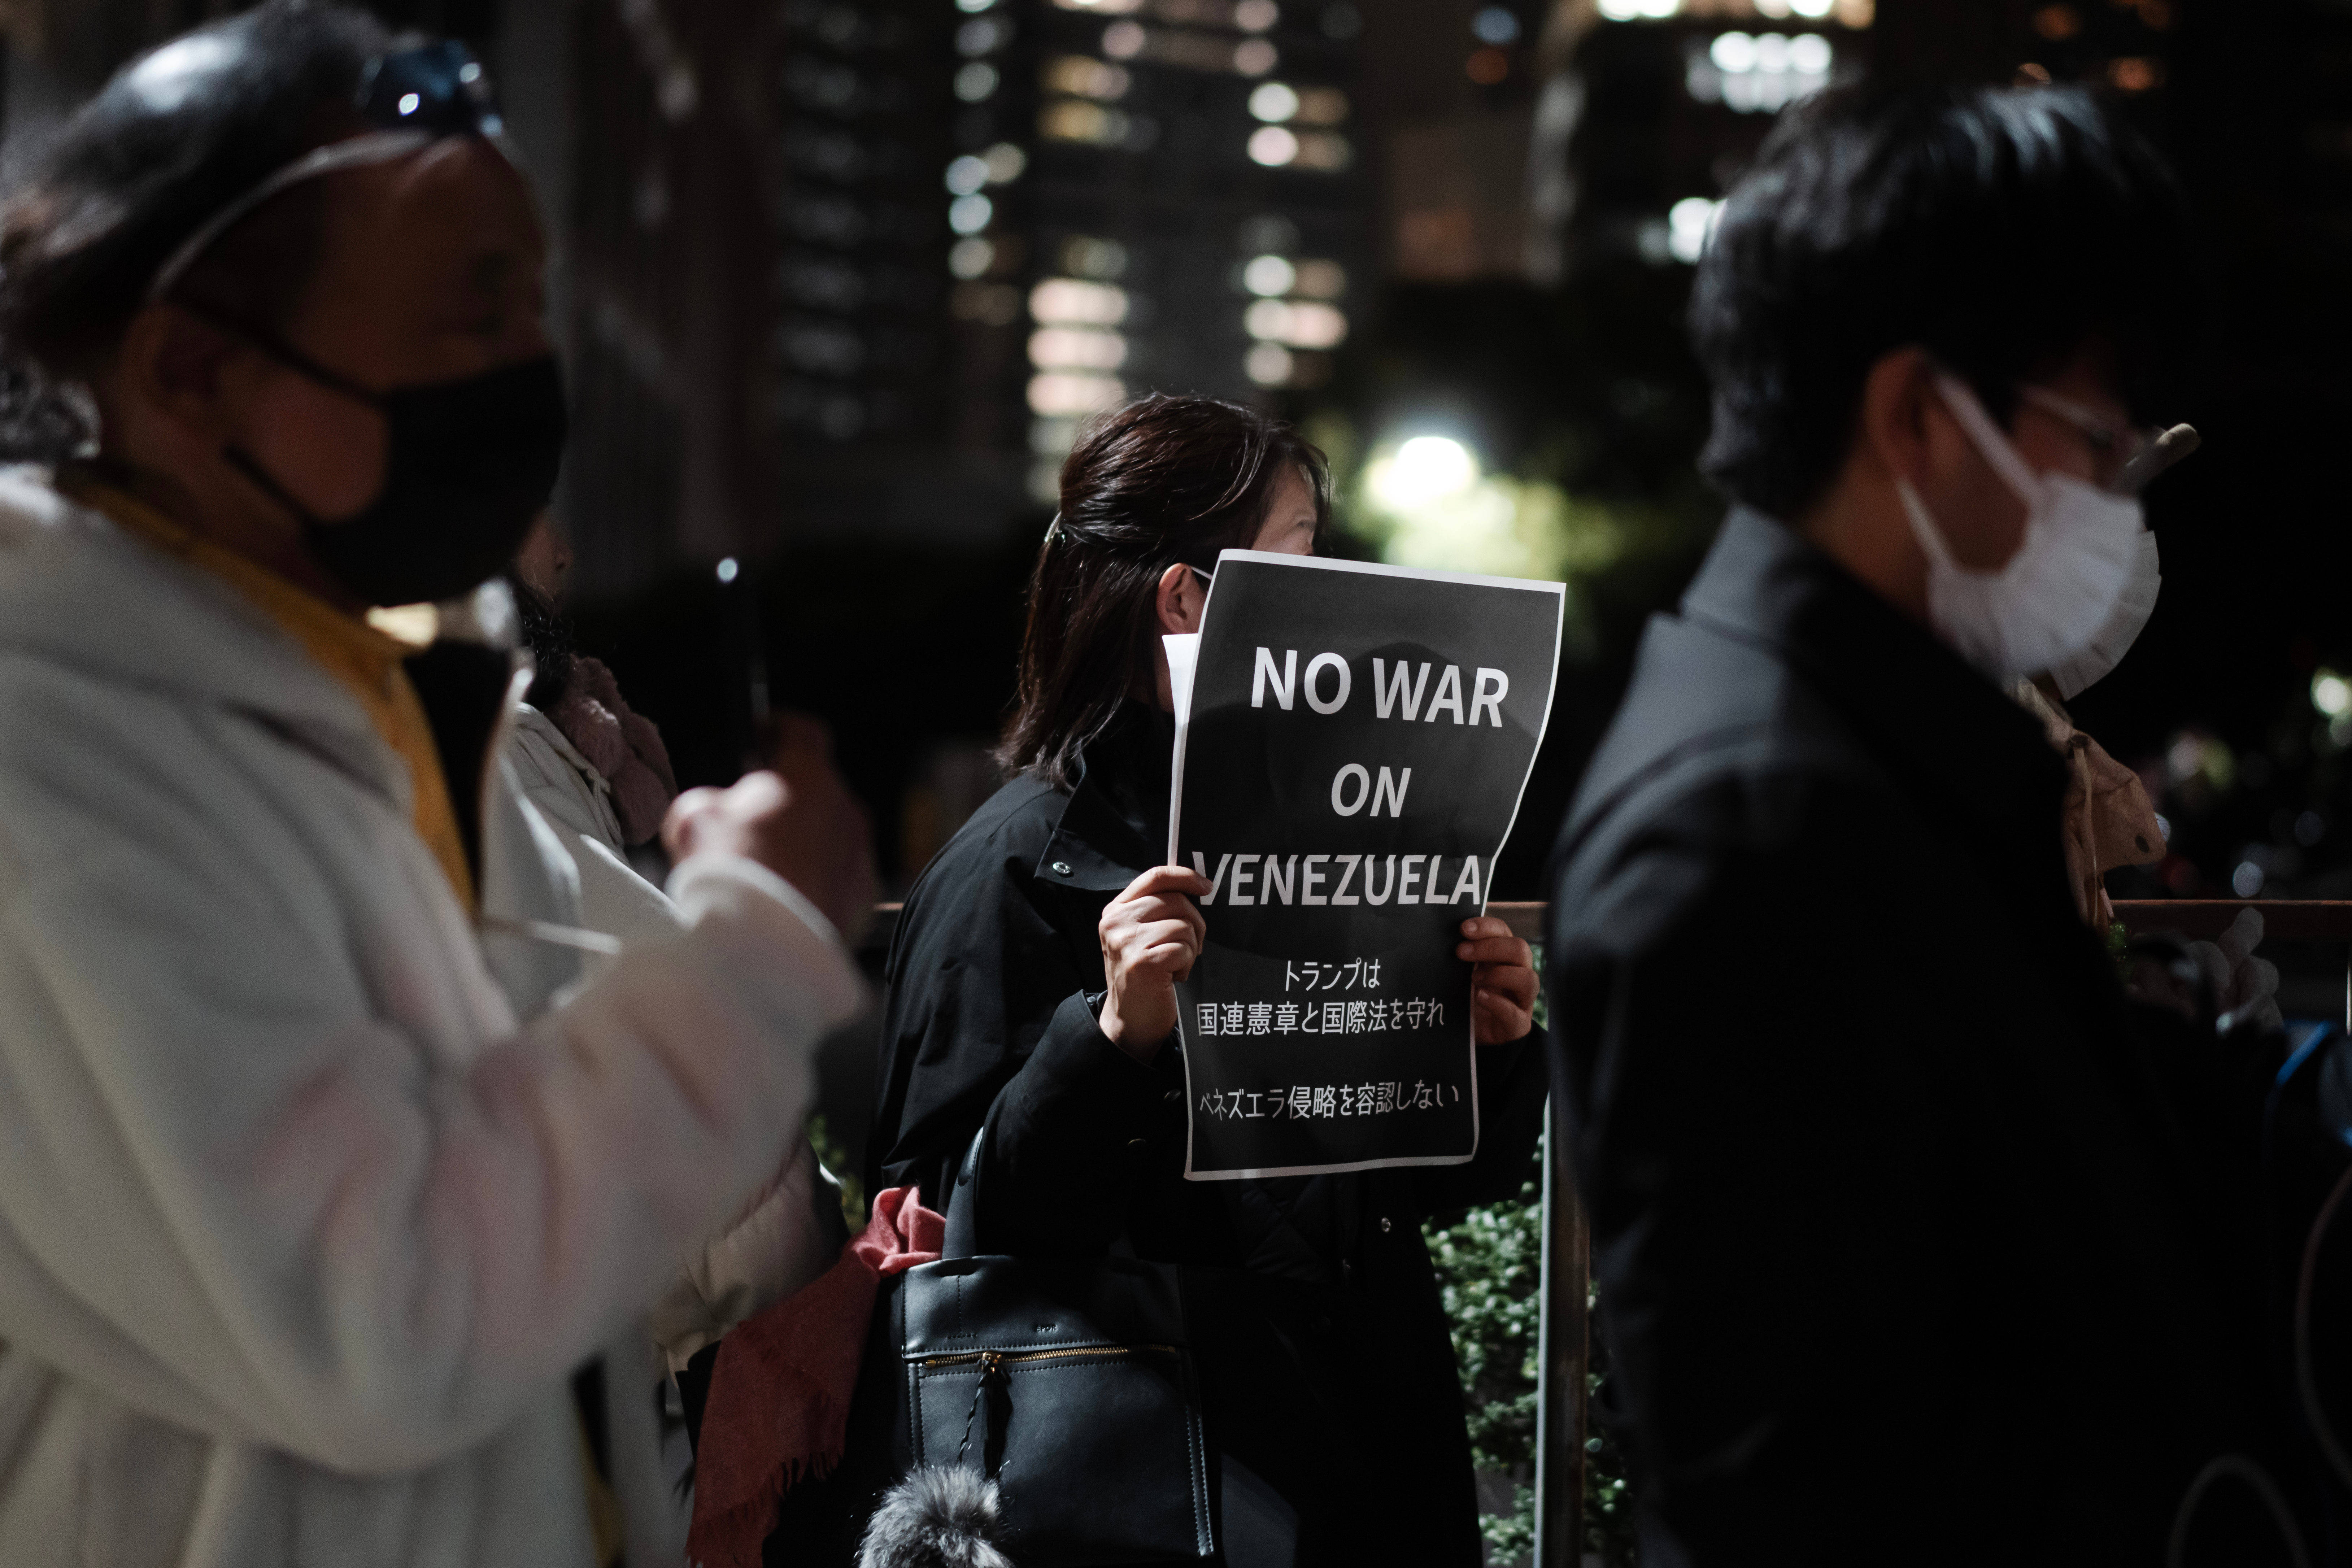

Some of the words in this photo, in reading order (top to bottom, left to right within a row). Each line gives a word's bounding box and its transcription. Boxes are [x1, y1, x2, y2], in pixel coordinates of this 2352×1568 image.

[1251, 646, 1351, 714] NO
[1373, 658, 1509, 727] WAR
[1331, 763, 1411, 818] ON
[1192, 851, 1481, 906] VENEZUELA
[1285, 957, 1381, 991] トランプは
[1197, 997, 1444, 1036] 国連憲章と国際法を守れ
[1200, 1080, 1459, 1120] ベネズエラ侵略を容認しない
